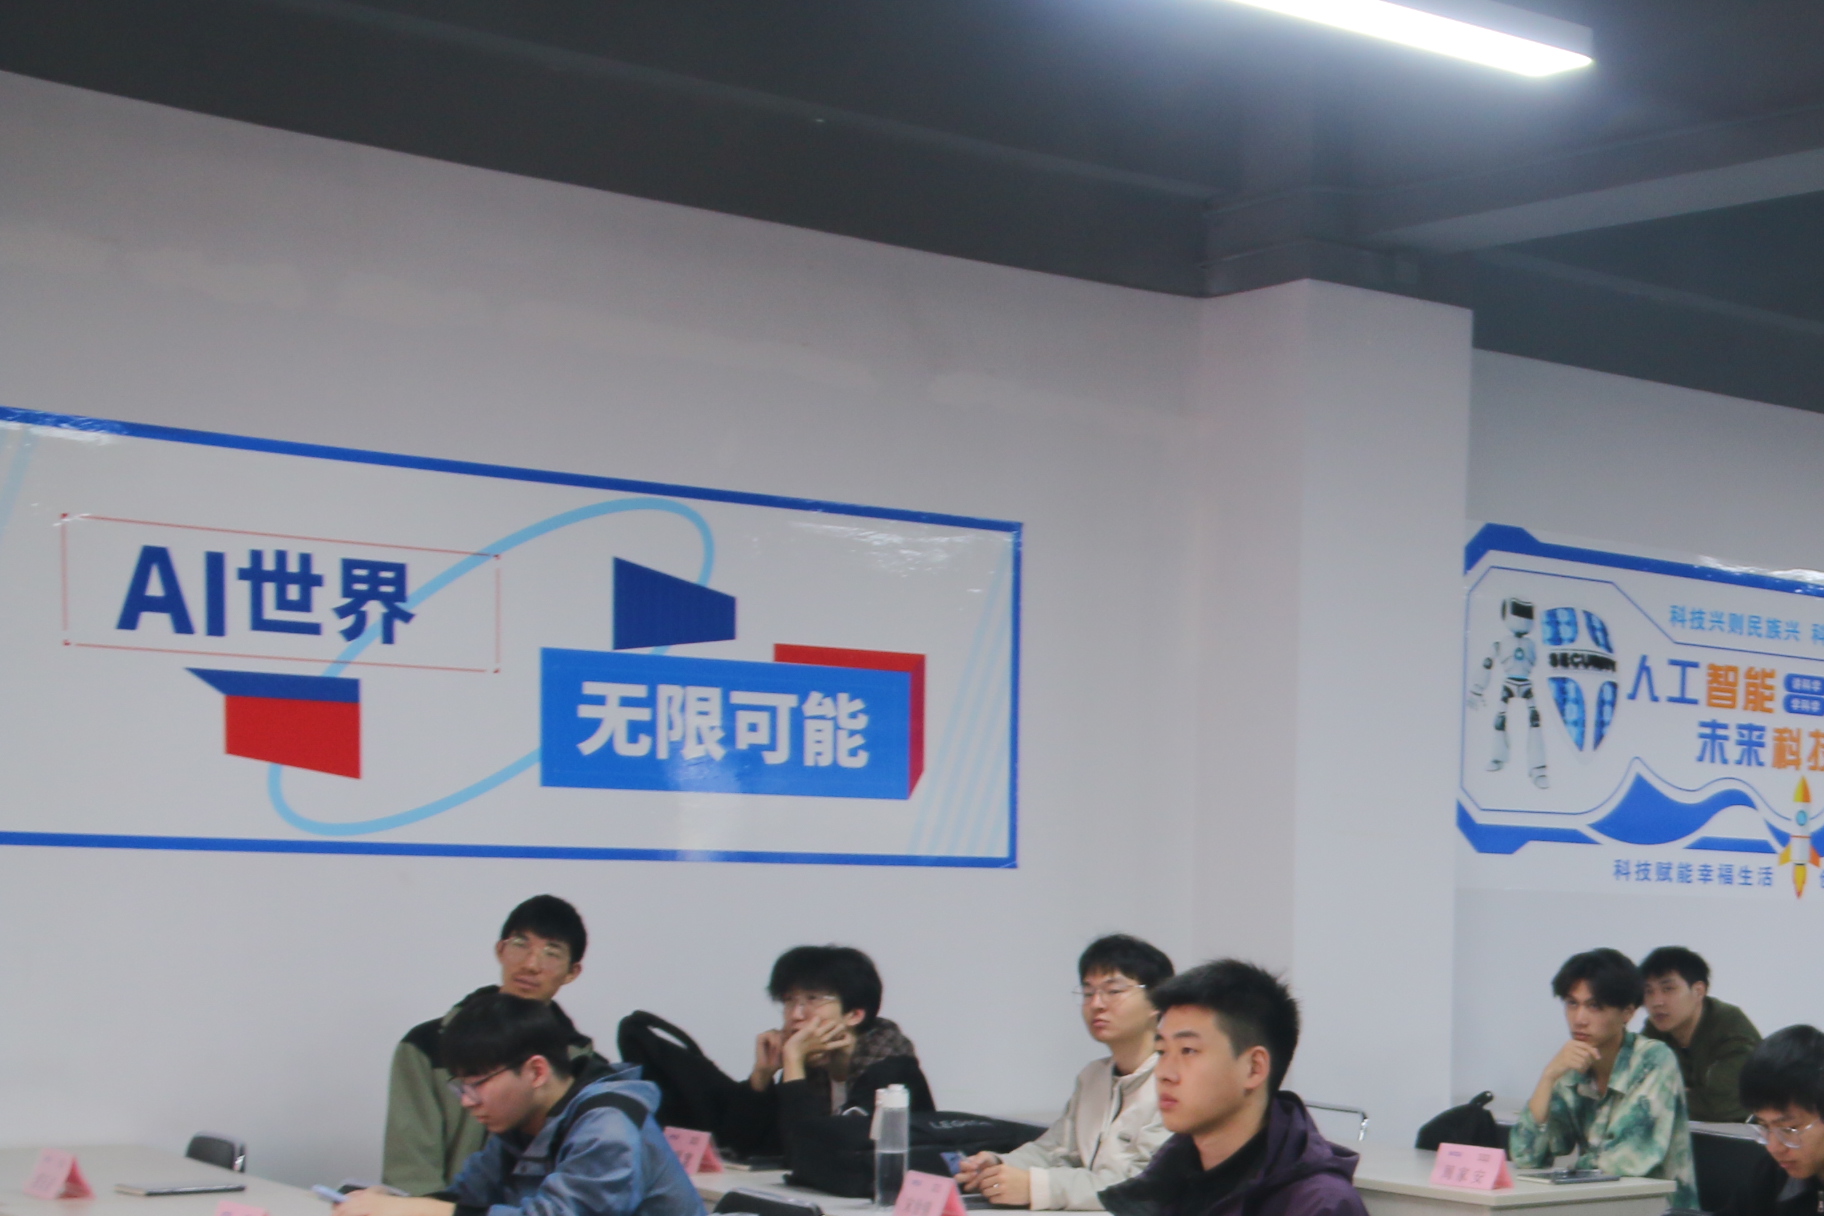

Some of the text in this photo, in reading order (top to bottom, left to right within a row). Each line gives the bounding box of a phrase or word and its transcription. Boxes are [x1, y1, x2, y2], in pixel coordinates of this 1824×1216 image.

[115, 545, 416, 645] AI世界
[1669, 604, 1800, 641] 科技兴则民族兴
[1627, 655, 1776, 714] 人工智能
[576, 681, 870, 771] 无限可能
[1613, 859, 1773, 887] 科技赋能幸福生活
